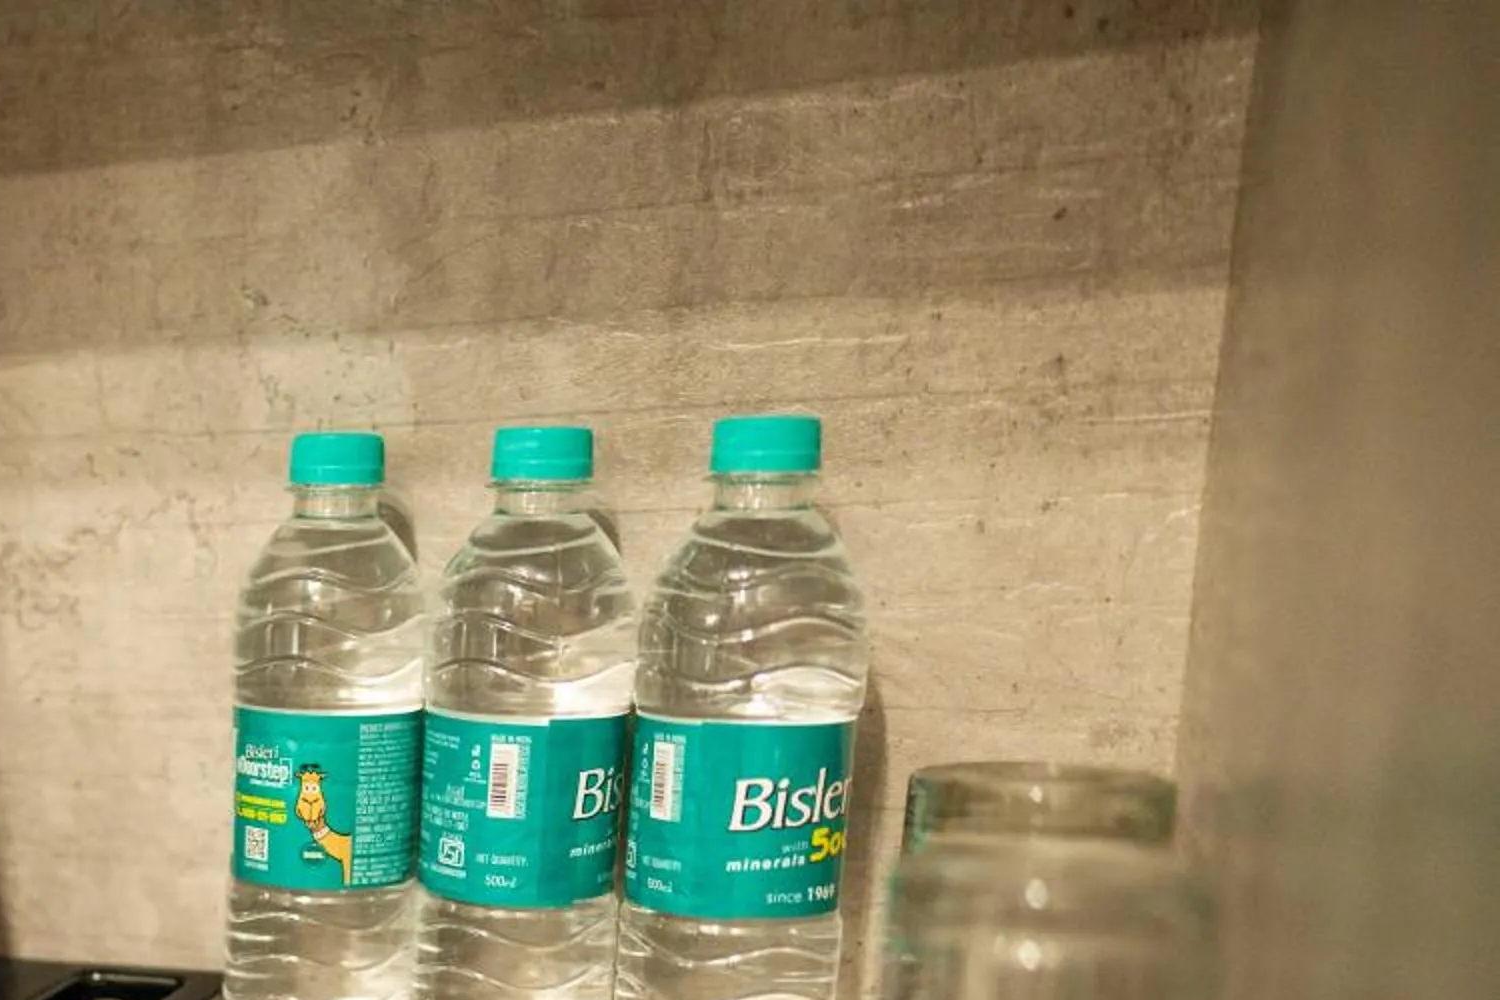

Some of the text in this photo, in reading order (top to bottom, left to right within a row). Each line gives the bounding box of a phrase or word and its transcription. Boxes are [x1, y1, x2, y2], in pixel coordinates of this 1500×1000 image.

[245, 743, 279, 759] Bisleri
[725, 854, 806, 873] minerals
[765, 889, 803, 904] since
